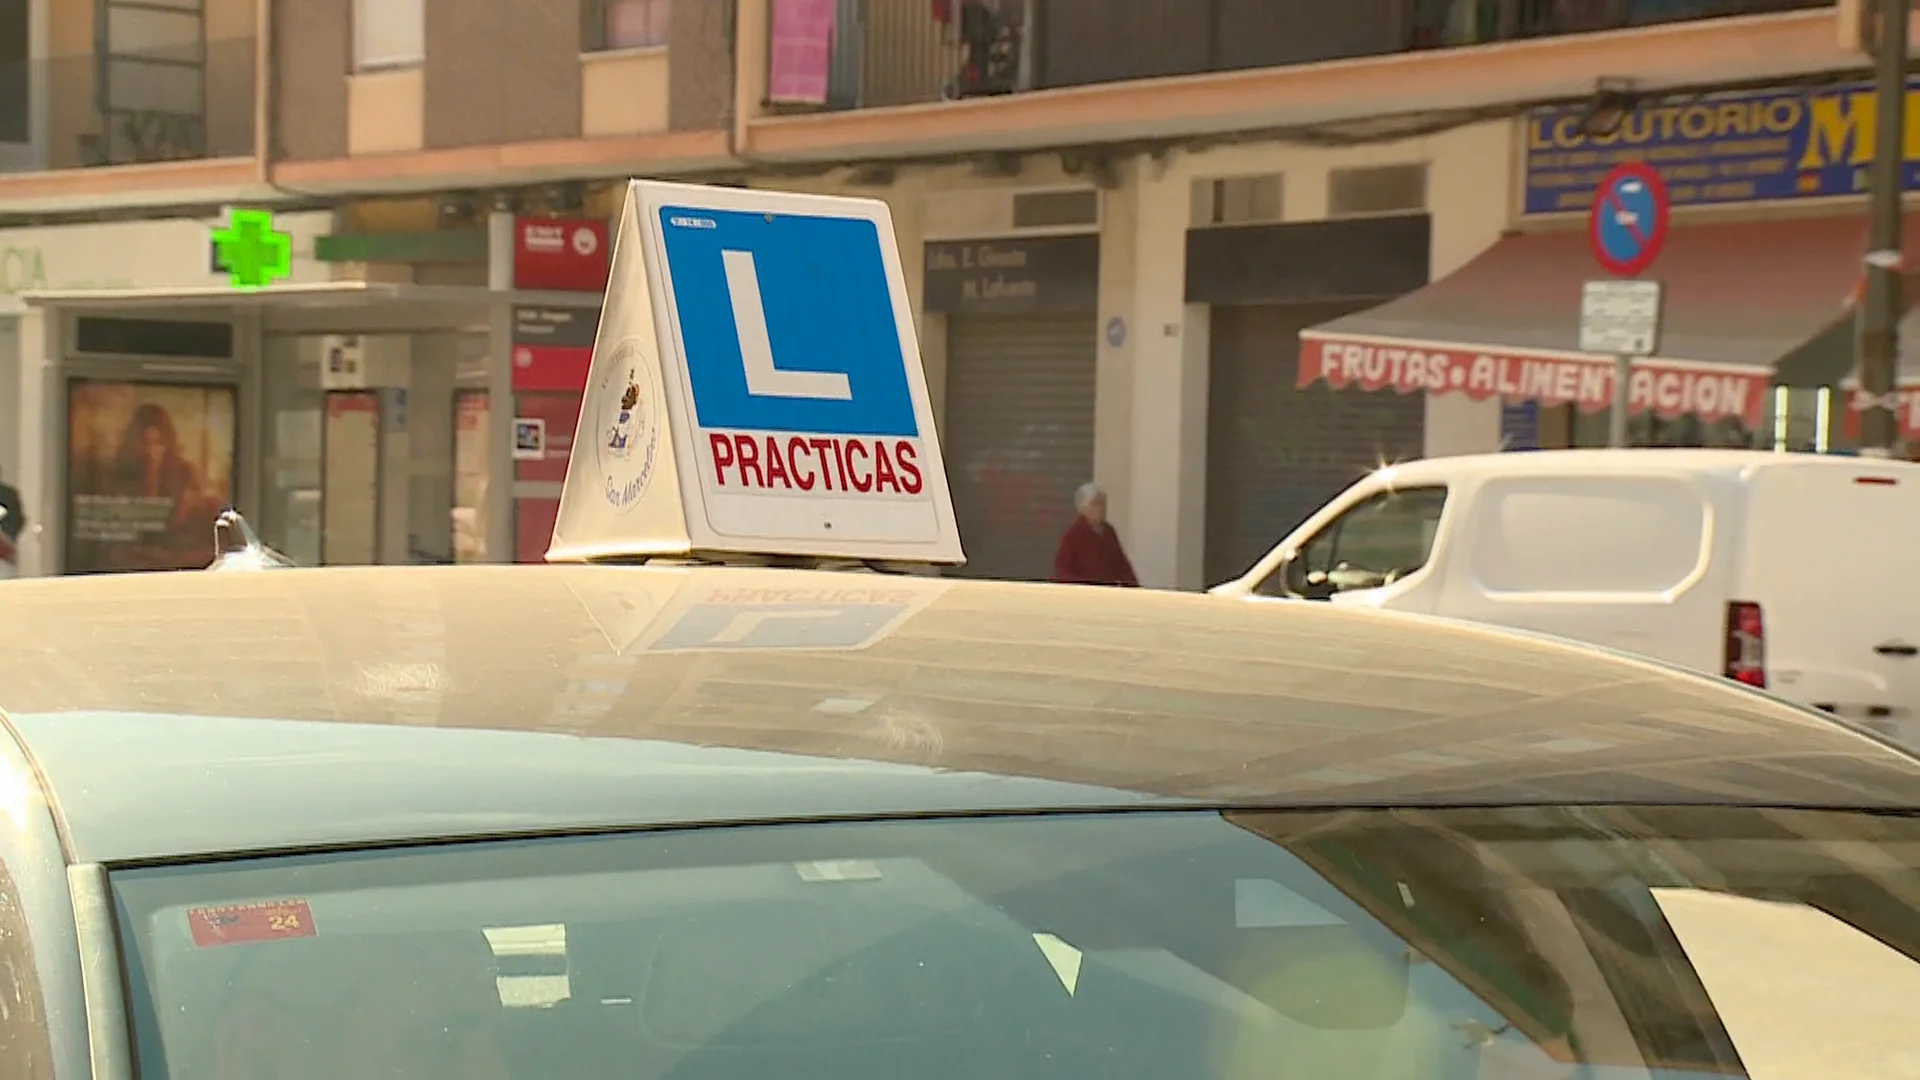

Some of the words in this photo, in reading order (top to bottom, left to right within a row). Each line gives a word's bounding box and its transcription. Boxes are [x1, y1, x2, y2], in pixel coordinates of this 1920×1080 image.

[721, 249, 853, 401] L
[1320, 344, 1451, 390] FRUTAS
[709, 433, 923, 495] PRACTICAS
[268, 914, 301, 931] 24
